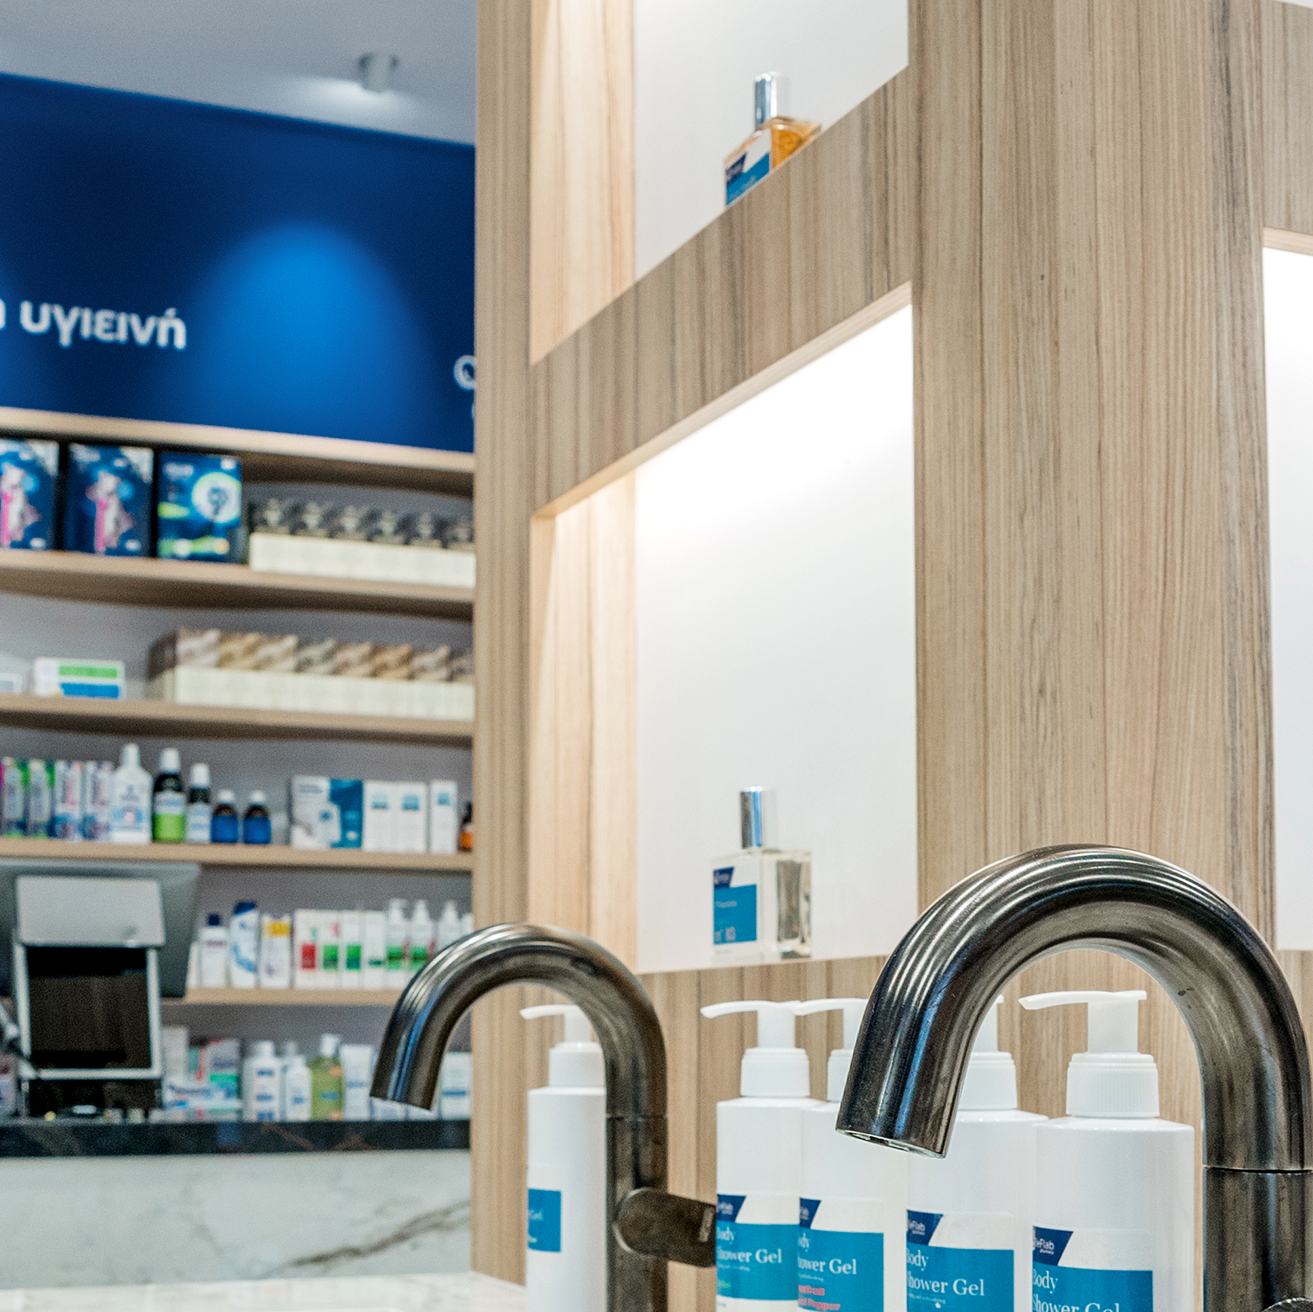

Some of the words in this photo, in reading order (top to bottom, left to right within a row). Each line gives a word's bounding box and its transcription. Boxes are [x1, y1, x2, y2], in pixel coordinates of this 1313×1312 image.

[19, 298, 188, 352] υγιεινή
[755, 1248, 783, 1264] Gel
[829, 1258, 857, 1275] Gel
[953, 1278, 985, 1296] Gel
